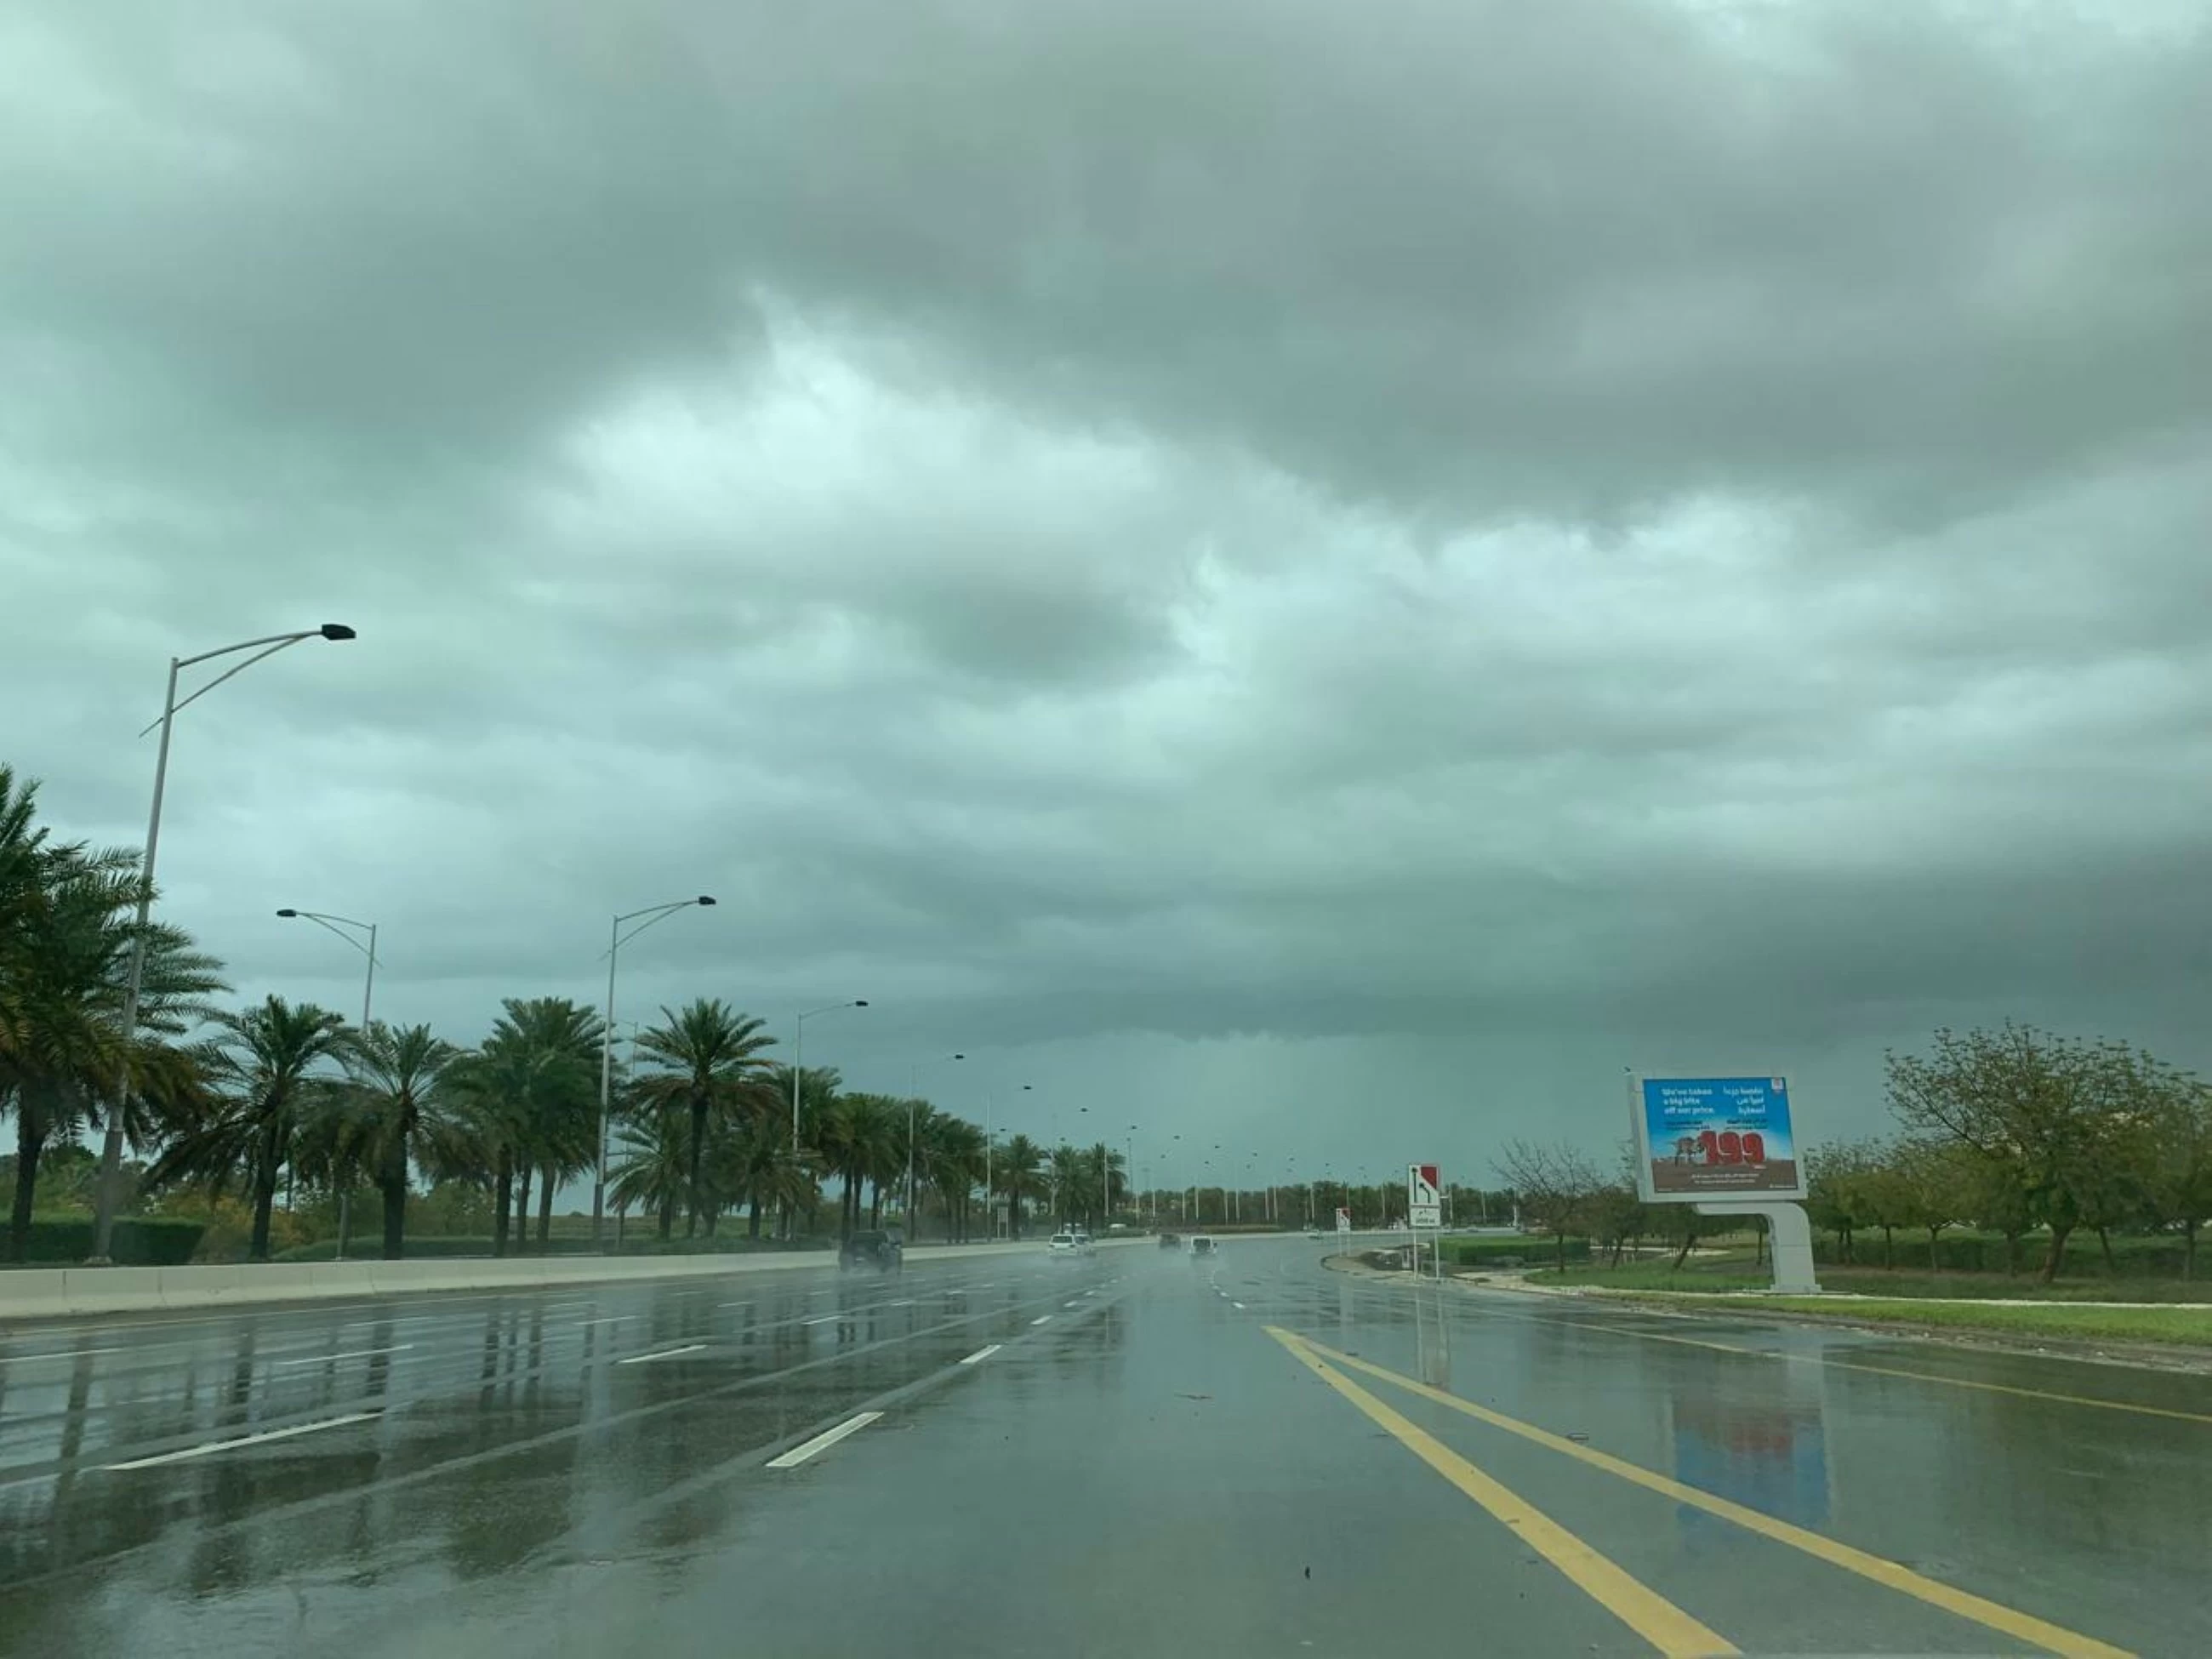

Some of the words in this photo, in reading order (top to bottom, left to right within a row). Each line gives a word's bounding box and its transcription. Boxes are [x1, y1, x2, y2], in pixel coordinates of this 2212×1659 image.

[1669, 1097, 1683, 1107] big
[1684, 1097, 1700, 1105] bite
[1664, 1106, 1676, 1115] off
[1699, 1130, 1765, 1166] 199
